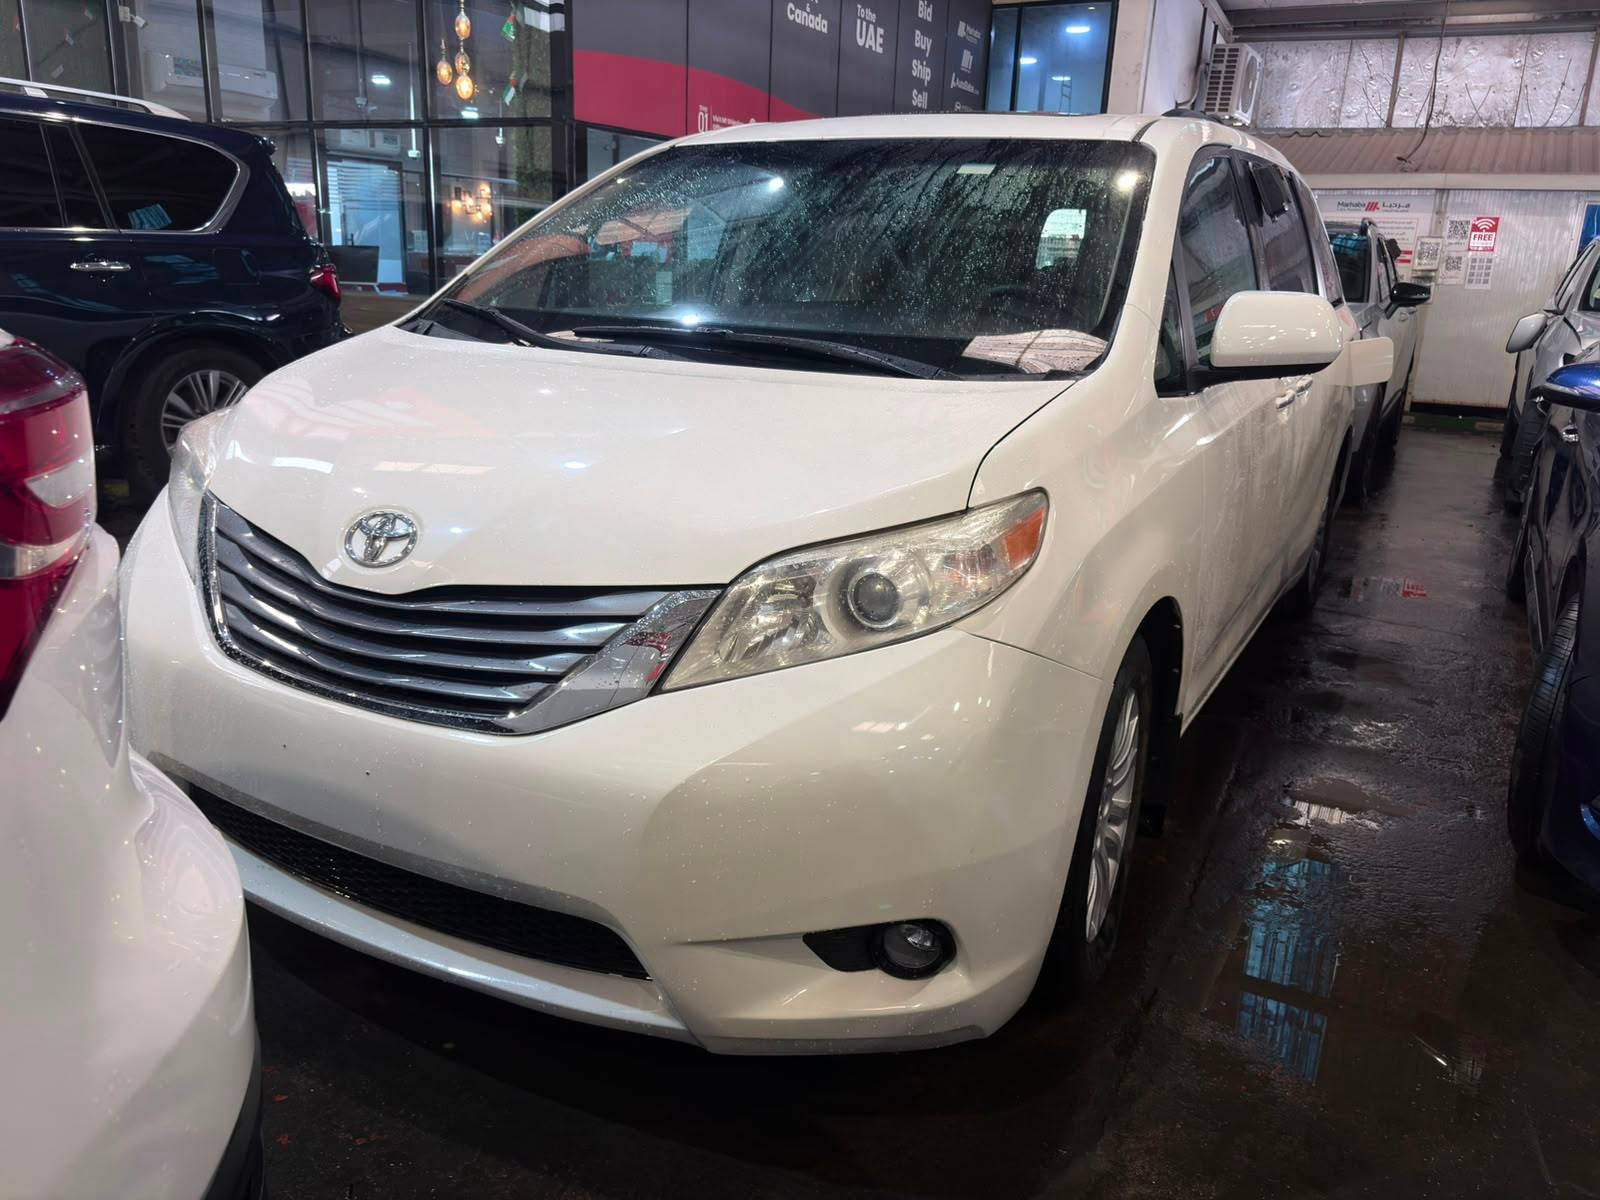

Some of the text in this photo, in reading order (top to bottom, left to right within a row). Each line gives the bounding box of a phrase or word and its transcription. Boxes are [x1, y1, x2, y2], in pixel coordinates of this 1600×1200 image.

[787, 2, 828, 34] Canada
[857, 4, 877, 23] To the
[918, 0, 933, 22] Bid
[856, 18, 885, 54] UAE
[914, 29, 932, 57] Buy
[912, 59, 931, 87] Ship
[912, 88, 928, 109] Sell
[1337, 201, 1366, 209] Marhaba
[1473, 233, 1494, 241] FREE
